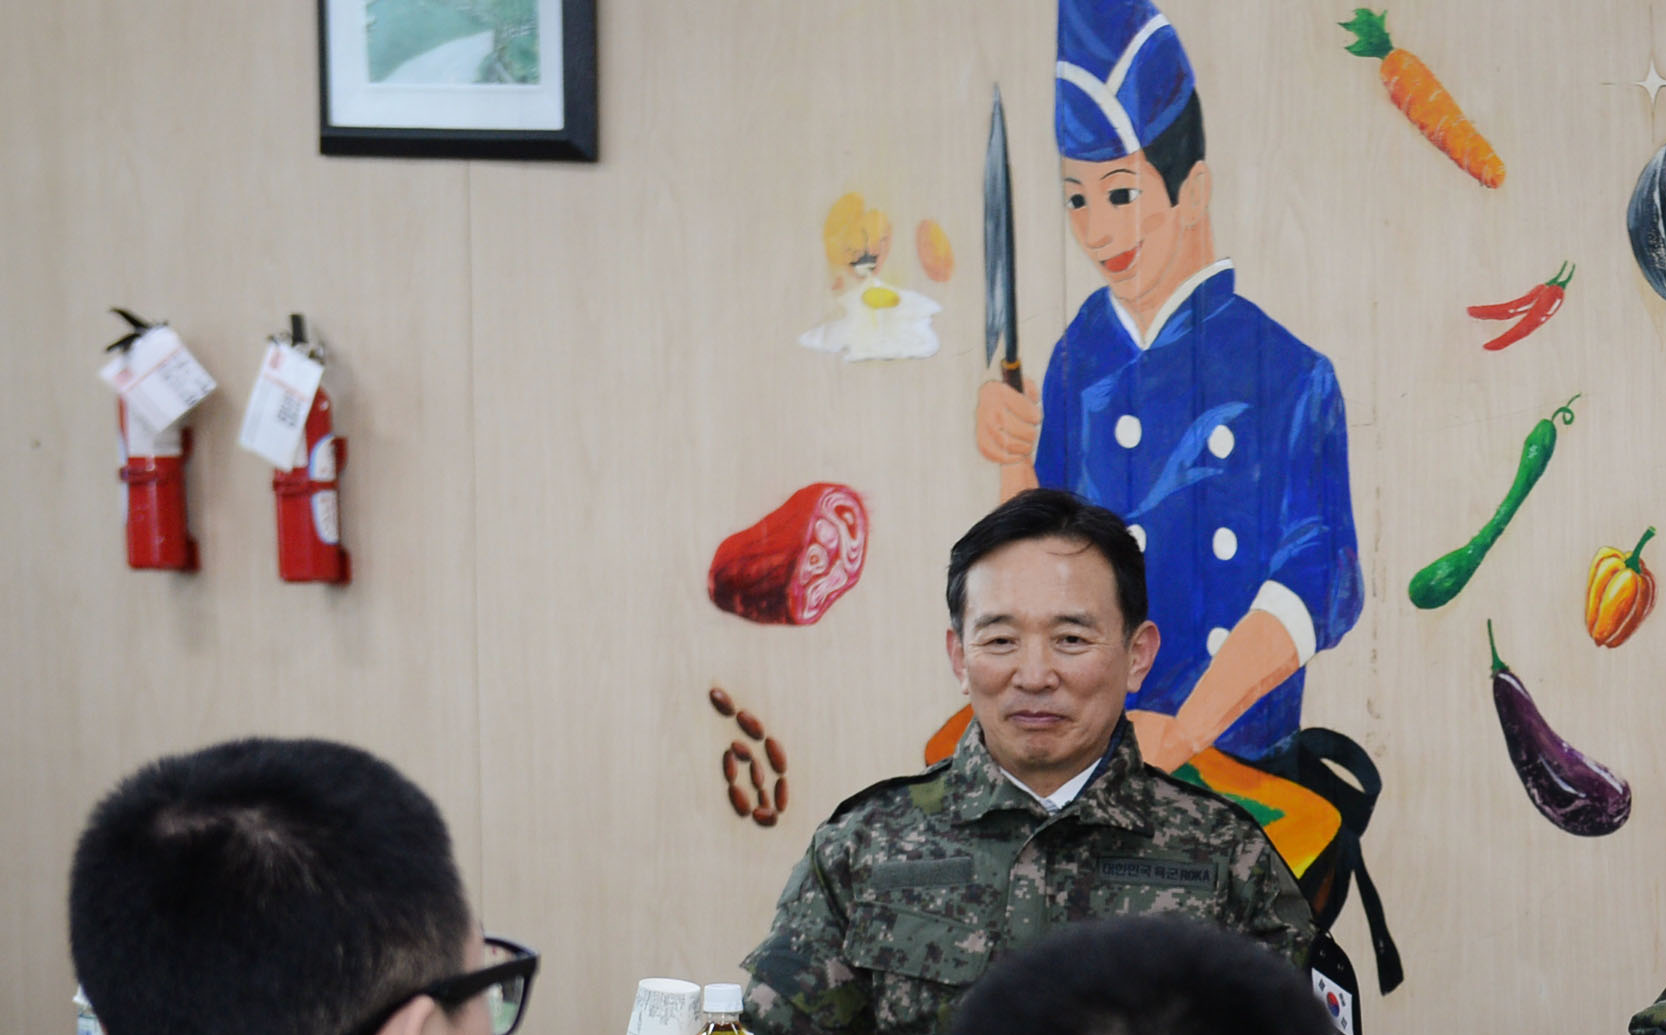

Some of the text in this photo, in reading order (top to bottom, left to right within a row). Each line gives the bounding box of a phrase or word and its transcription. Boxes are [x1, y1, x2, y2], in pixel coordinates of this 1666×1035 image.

[1102, 862, 1210, 882] 대한민국 육군 ROKA
